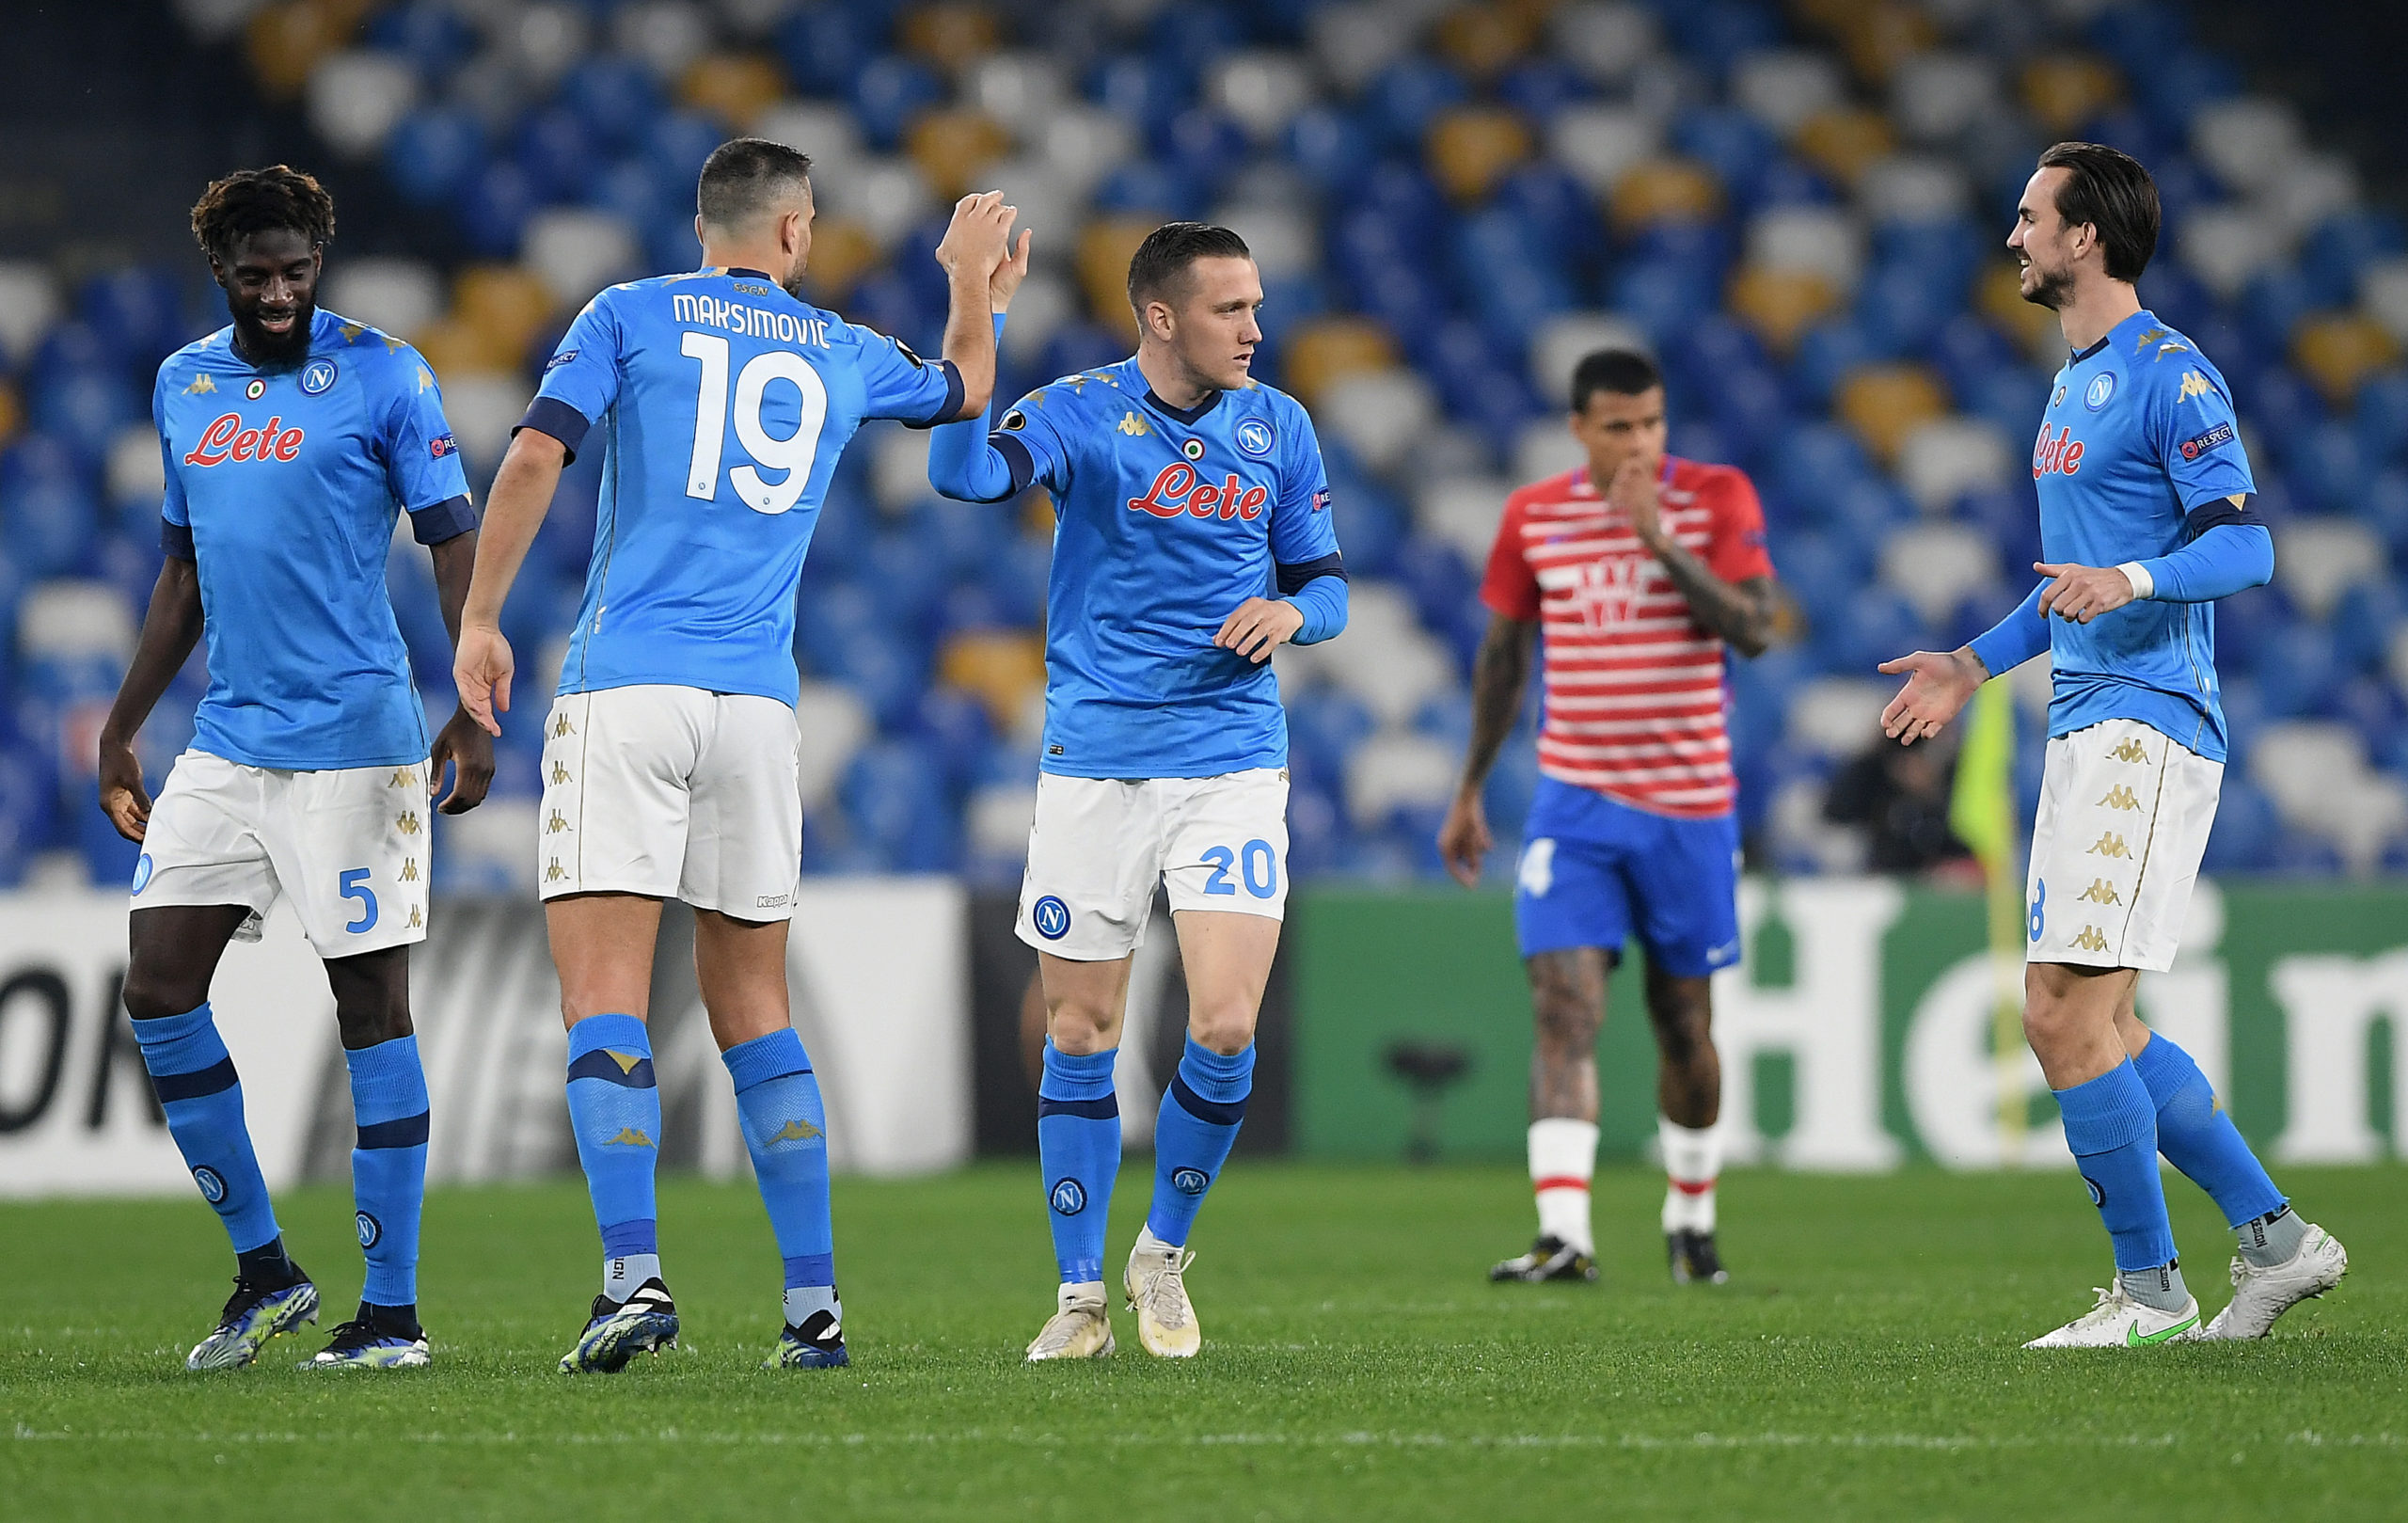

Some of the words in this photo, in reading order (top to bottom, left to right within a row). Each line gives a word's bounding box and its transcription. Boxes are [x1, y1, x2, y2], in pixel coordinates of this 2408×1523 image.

[733, 282, 768, 296] SSCN
[184, 412, 305, 467] Lete
[680, 330, 829, 516] 19
[2195, 425, 2233, 449] RESPECT
[1128, 462, 1268, 521] Lete
[1198, 838, 1277, 899] 20
[340, 867, 379, 934] 5
[756, 894, 788, 908] Kappa
[2029, 877, 2046, 943] 8
